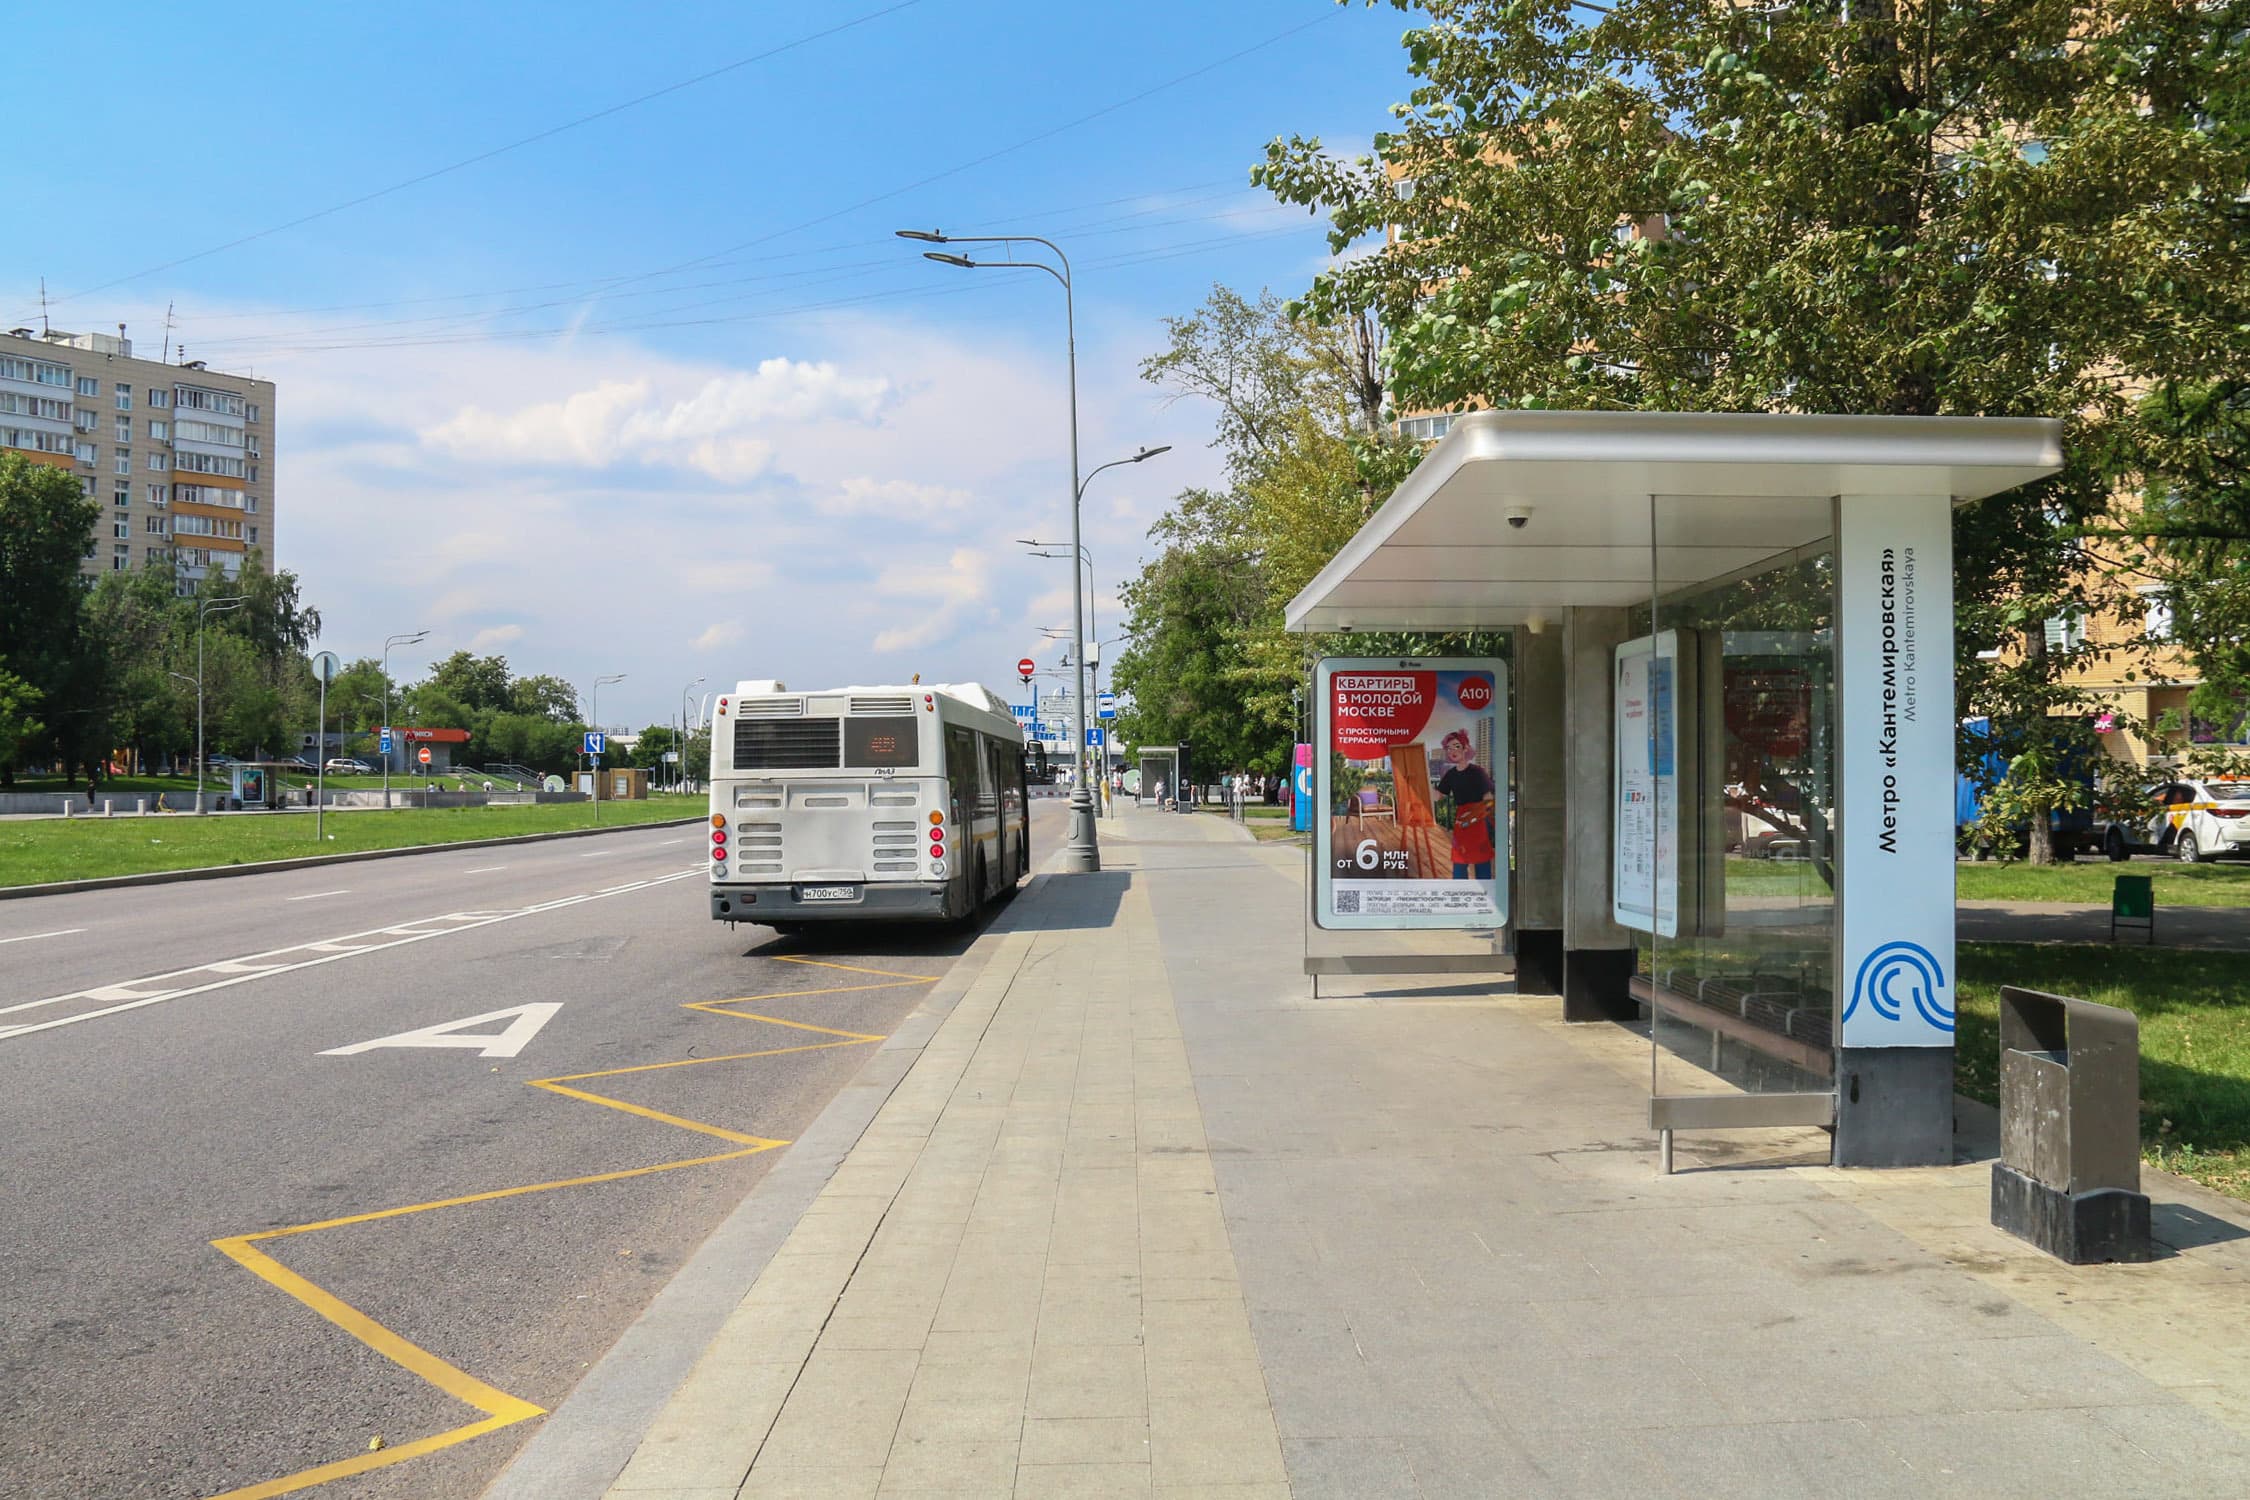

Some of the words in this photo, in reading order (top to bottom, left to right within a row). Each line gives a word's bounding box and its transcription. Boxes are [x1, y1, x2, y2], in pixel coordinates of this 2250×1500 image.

[1902, 547, 1917, 672] Kantemirovskaya
[1879, 548, 1900, 768] «Кантемировская»
[1338, 678, 1414, 689] КВАРТИРЫ
[1338, 695, 1347, 704] В
[1351, 692, 1422, 706] МОЛОДОЙ
[1460, 687, 1490, 699] А101
[1904, 676, 1916, 722] Metro
[1338, 706, 1395, 717] МОСКВЕ
[1345, 727, 1410, 736] ПРОСТОРНЫМИ
[1338, 736, 1387, 744] ТЕРРАСАМИ
[1879, 775, 1900, 853] Метро
[1336, 859, 1353, 869] ОТ
[1355, 838, 1380, 871] 6
[1383, 850, 1409, 860] МЛН
[1383, 861, 1409, 870] РУБ.
